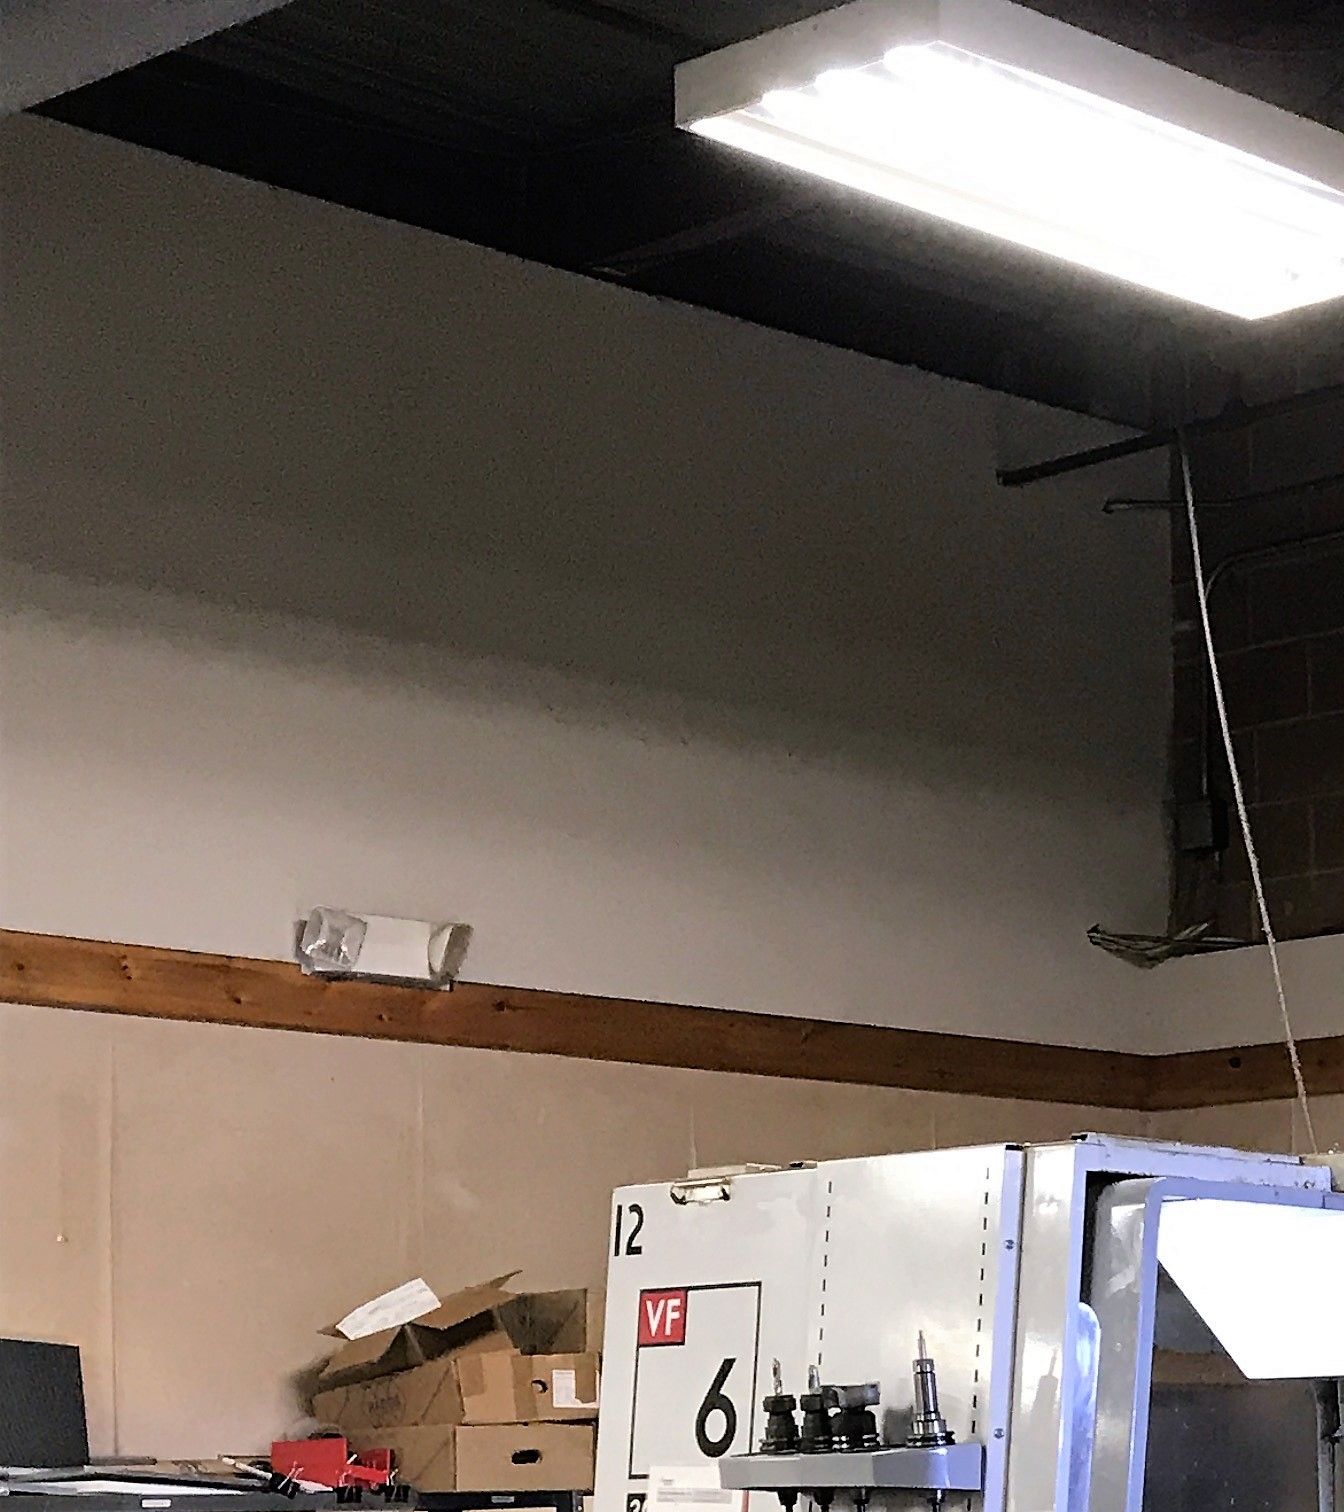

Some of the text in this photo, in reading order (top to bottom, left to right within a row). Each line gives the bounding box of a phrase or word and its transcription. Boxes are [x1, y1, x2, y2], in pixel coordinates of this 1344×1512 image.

[614, 1203, 645, 1257] 12
[645, 1298, 681, 1337] VF
[696, 1358, 737, 1458] 6
